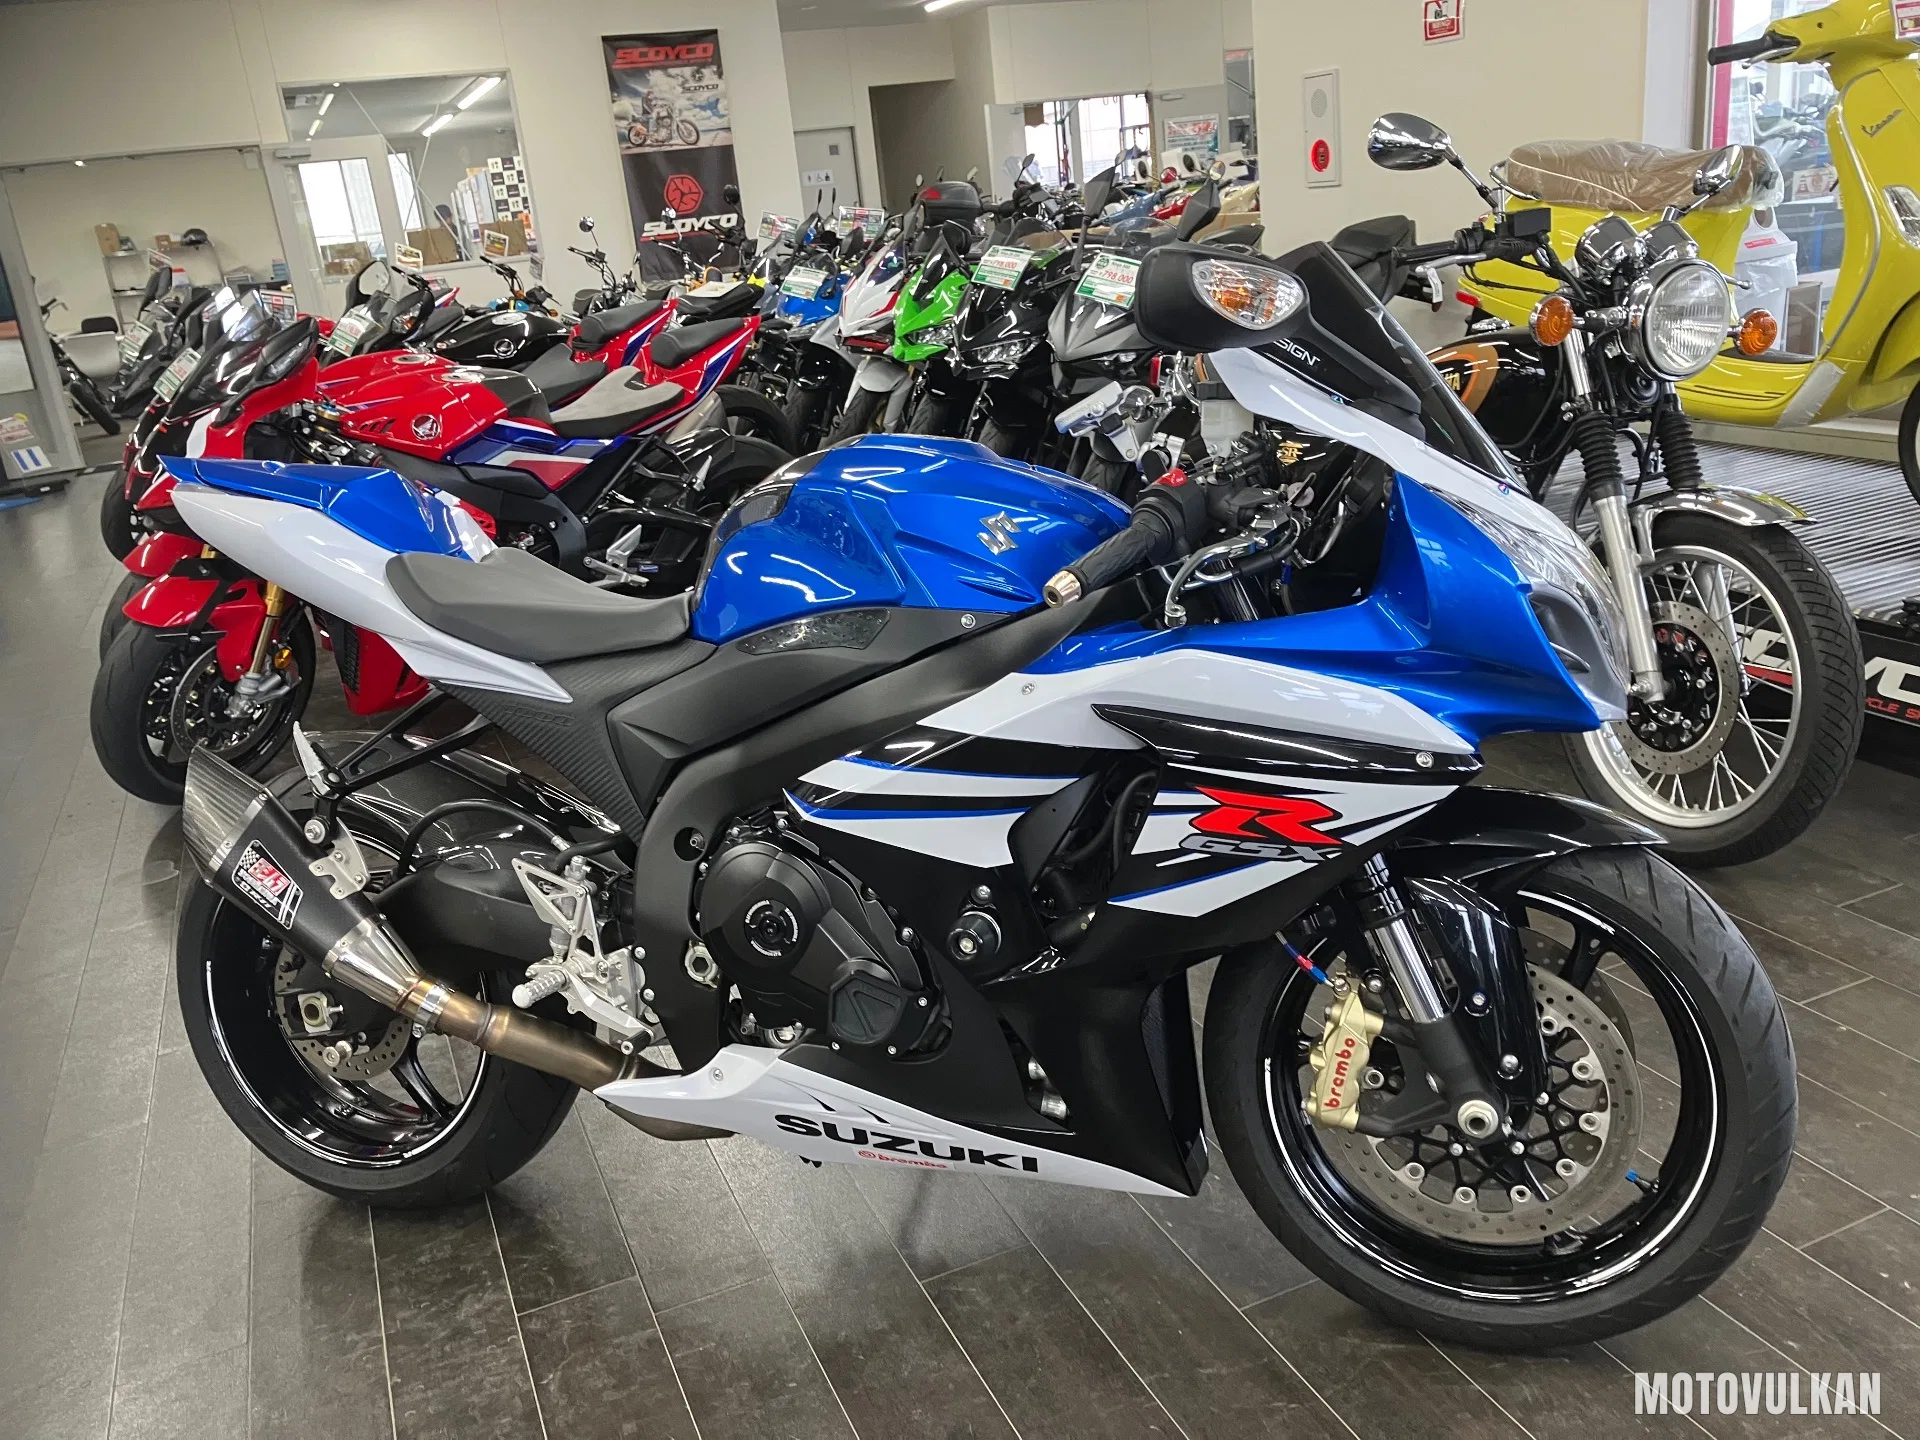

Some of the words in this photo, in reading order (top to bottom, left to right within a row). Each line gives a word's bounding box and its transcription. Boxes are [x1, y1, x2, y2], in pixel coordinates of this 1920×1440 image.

[615, 43, 714, 63] SCOYCO
[641, 213, 739, 237] SCOYCO
[1281, 446, 1299, 459] SR
[1193, 785, 1344, 845] R
[1180, 834, 1342, 861] GSX
[1323, 1037, 1356, 1109] brembo
[774, 1113, 1039, 1174] SUZUKI
[876, 1153, 948, 1169] brembo
